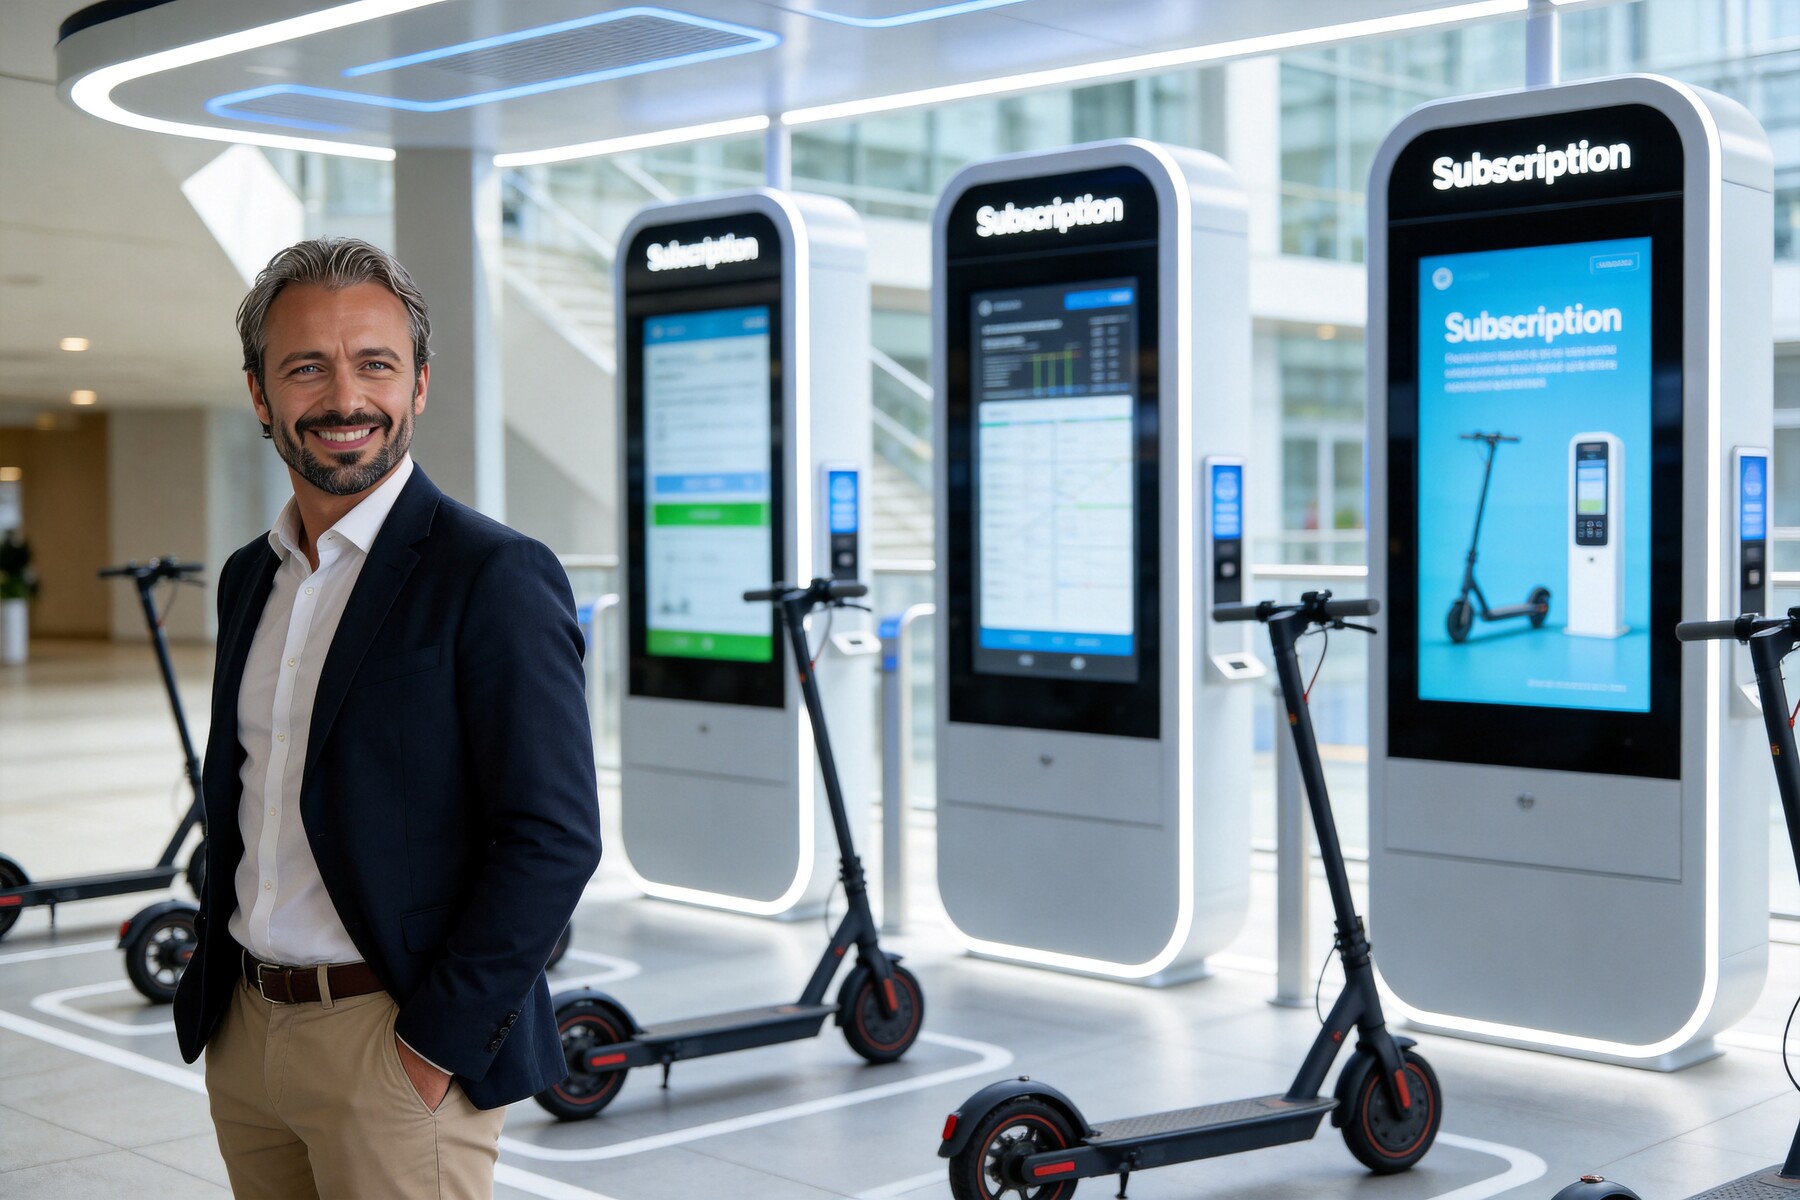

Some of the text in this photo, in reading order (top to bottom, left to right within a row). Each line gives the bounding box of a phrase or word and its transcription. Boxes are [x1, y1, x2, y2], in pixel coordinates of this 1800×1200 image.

[1432, 139, 1631, 190] Subscription
[976, 193, 1124, 237] Subscription
[1444, 303, 1622, 344] Subscription
